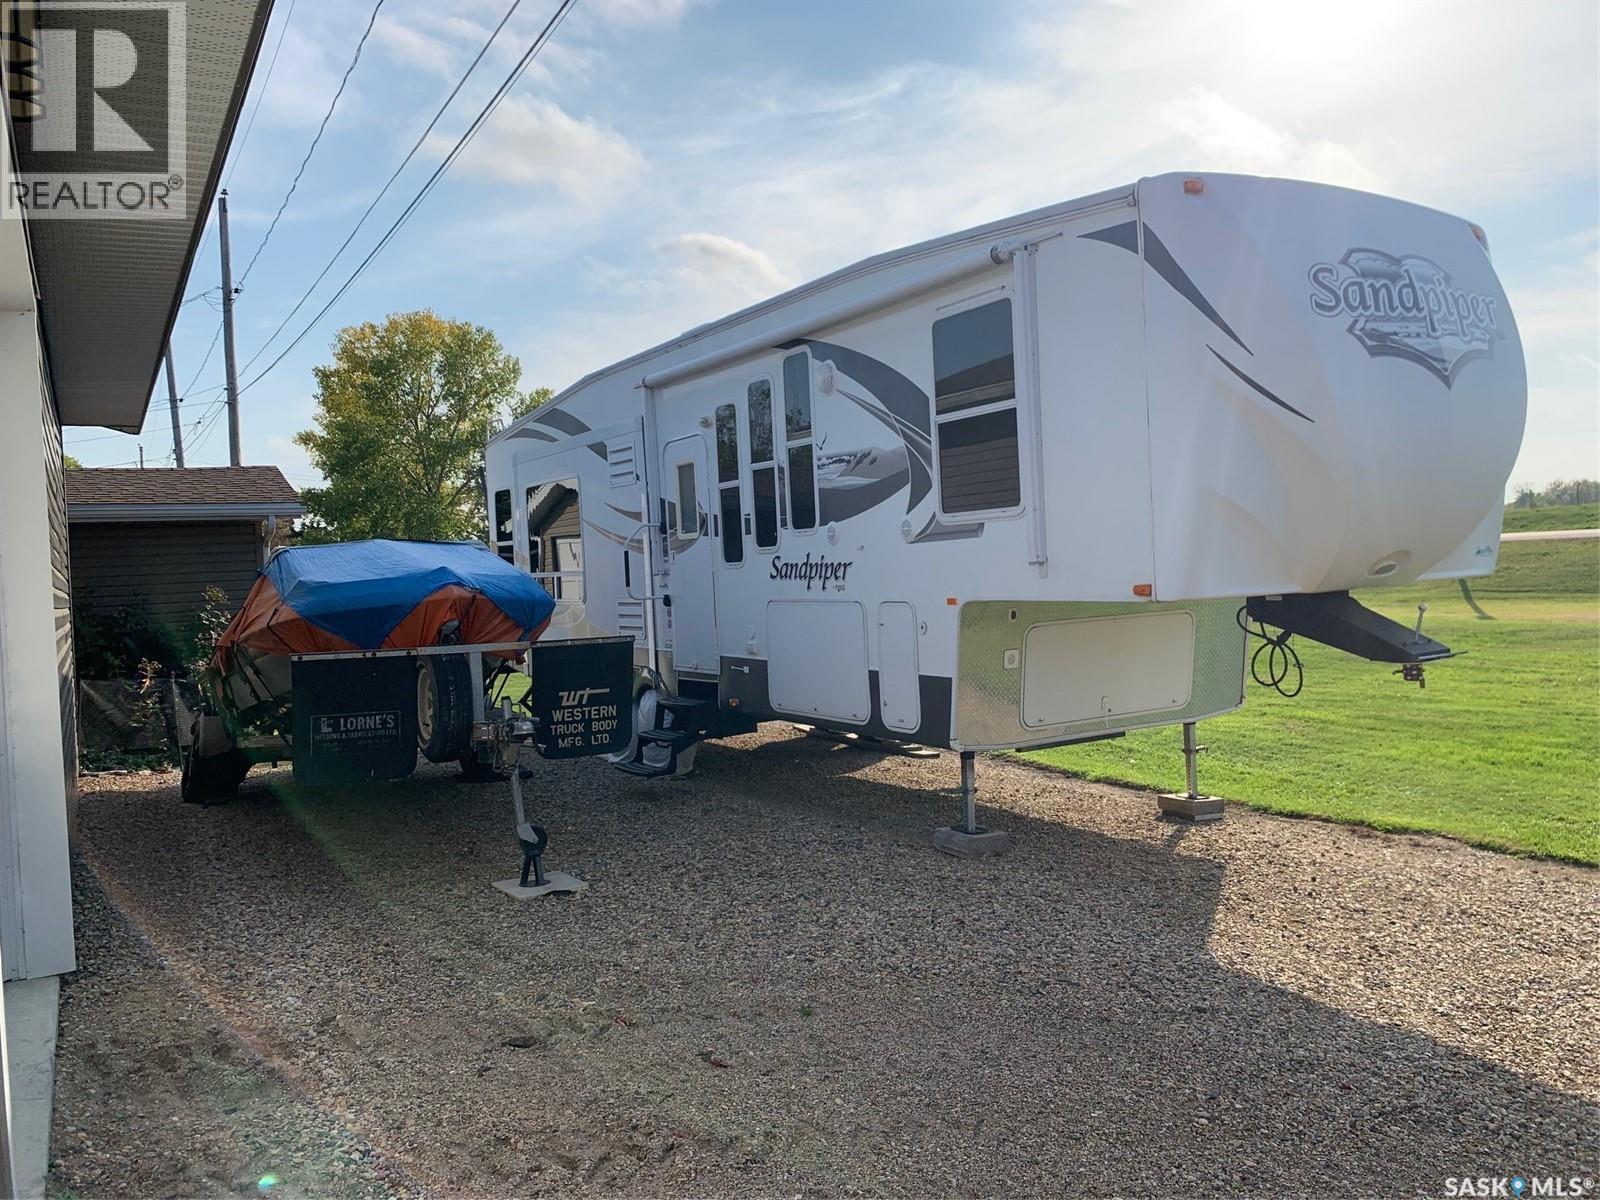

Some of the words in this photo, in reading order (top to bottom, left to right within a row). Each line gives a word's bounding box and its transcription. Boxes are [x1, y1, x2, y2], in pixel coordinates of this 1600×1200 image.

[1308, 263, 1496, 343] Sandpiper
[770, 552, 854, 592] Sandpiper
[551, 705, 617, 722] WESTERN
[340, 714, 395, 731] LORNE'S
[550, 723, 585, 735] TRUCK
[592, 720, 618, 732] BODY
[558, 737, 585, 748] MFG.
